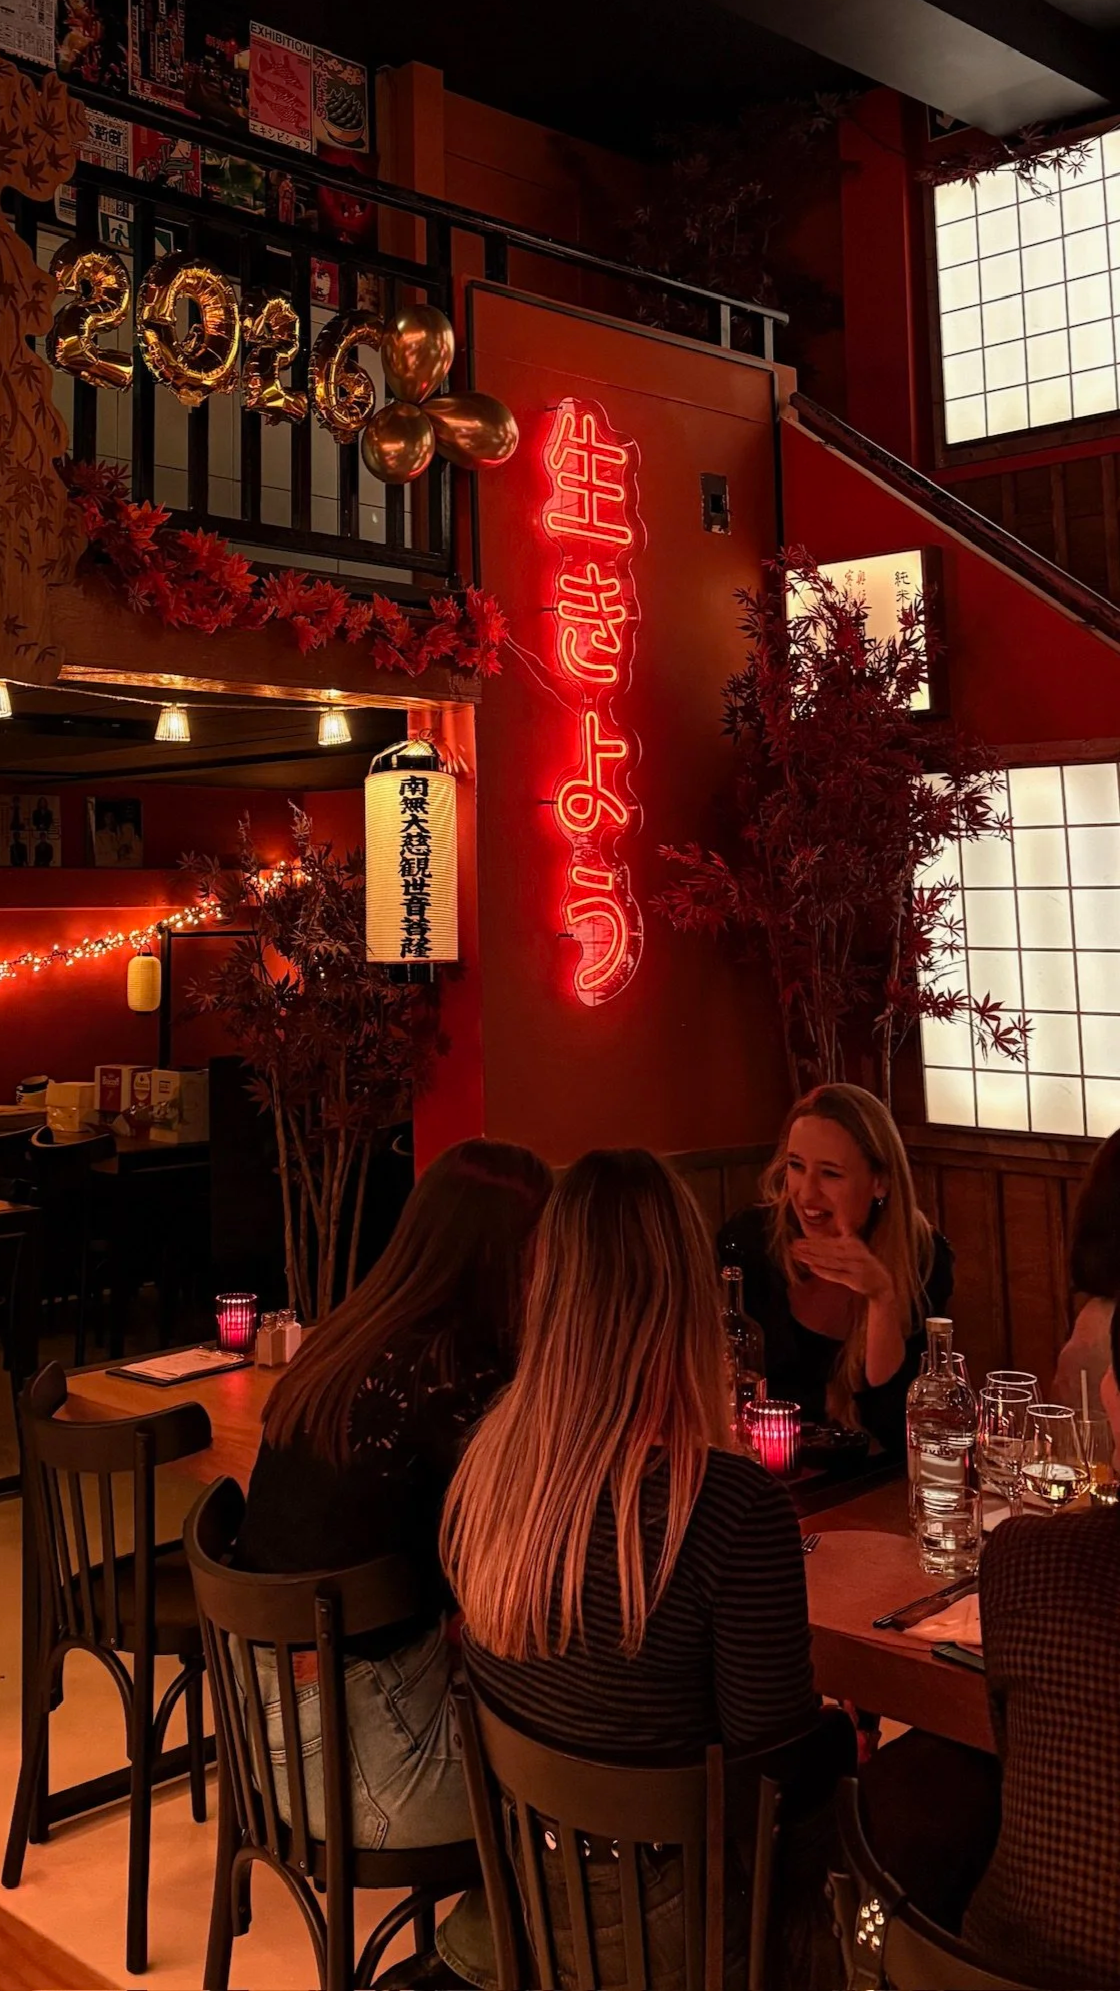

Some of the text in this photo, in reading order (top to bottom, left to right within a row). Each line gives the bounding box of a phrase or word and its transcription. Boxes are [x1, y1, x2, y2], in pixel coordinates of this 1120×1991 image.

[250, 22, 311, 57] EXHIBITION
[250, 122, 310, 150] エキシビション
[46, 244, 385, 444] 2026
[546, 412, 633, 991] 生きよう
